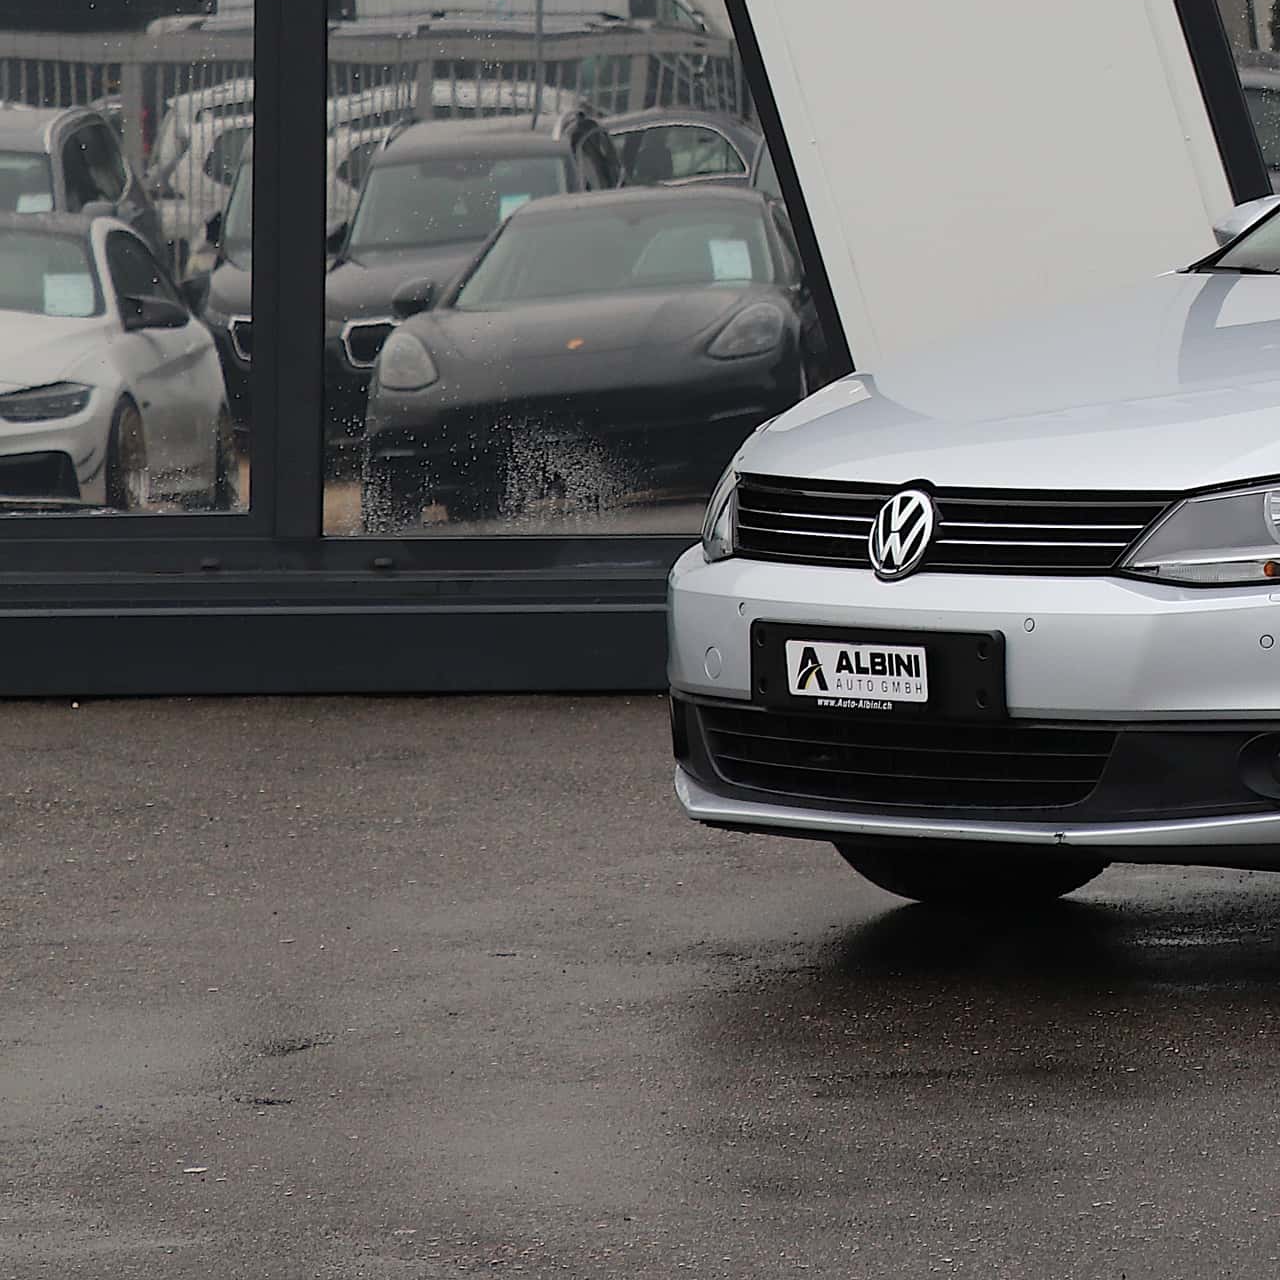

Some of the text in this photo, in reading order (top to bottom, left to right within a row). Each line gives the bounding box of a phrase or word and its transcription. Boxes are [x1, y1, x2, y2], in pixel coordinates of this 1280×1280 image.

[835, 650, 921, 678] ALBINI
[836, 677, 923, 695] AUTO GMBH
[817, 697, 893, 711] www.Auto-Albini.ch
